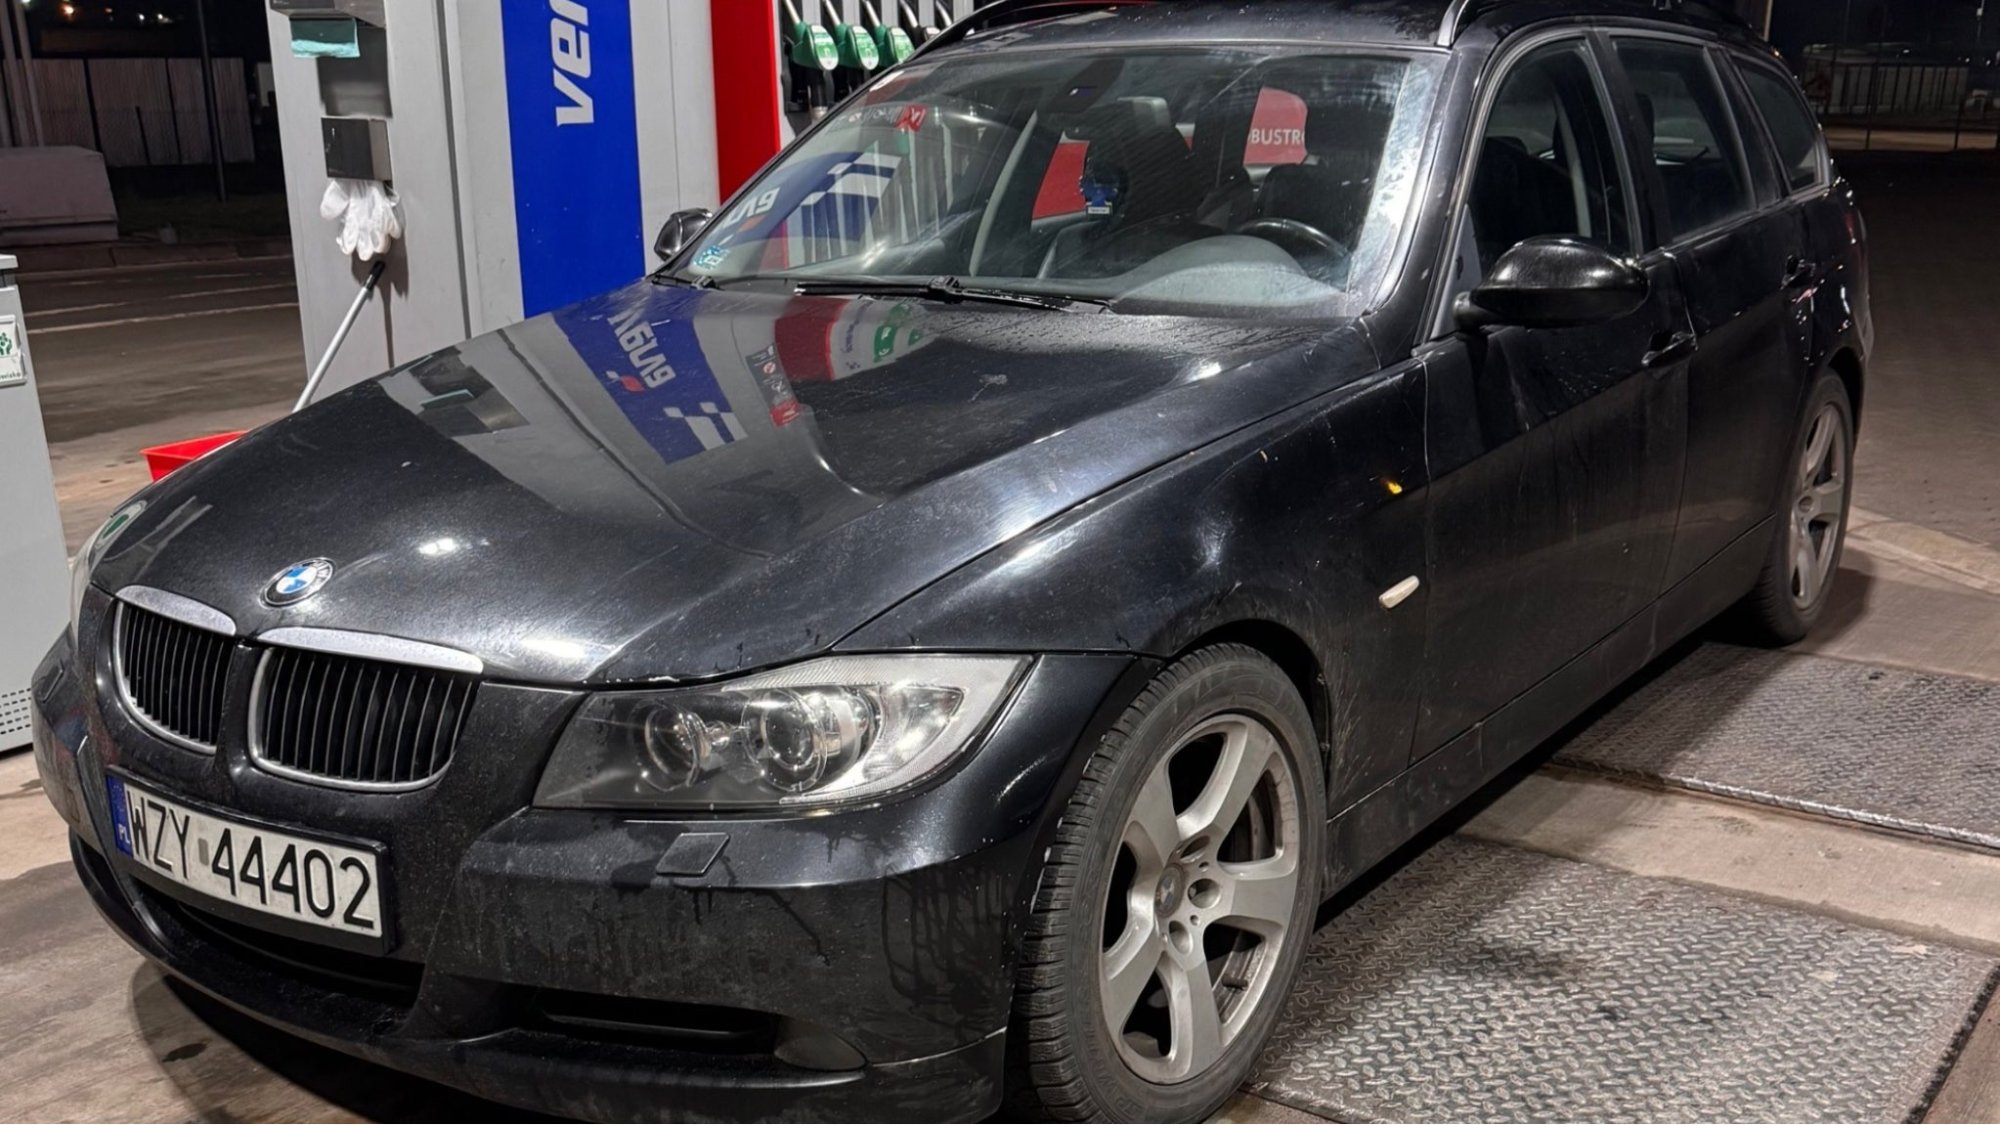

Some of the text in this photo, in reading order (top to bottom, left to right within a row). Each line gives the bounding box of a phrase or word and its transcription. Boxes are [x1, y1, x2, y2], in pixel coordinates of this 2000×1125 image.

[1249, 128, 1305, 145] BUSTR
[117, 823, 131, 844] PL
[127, 790, 375, 930] WZY 44402
